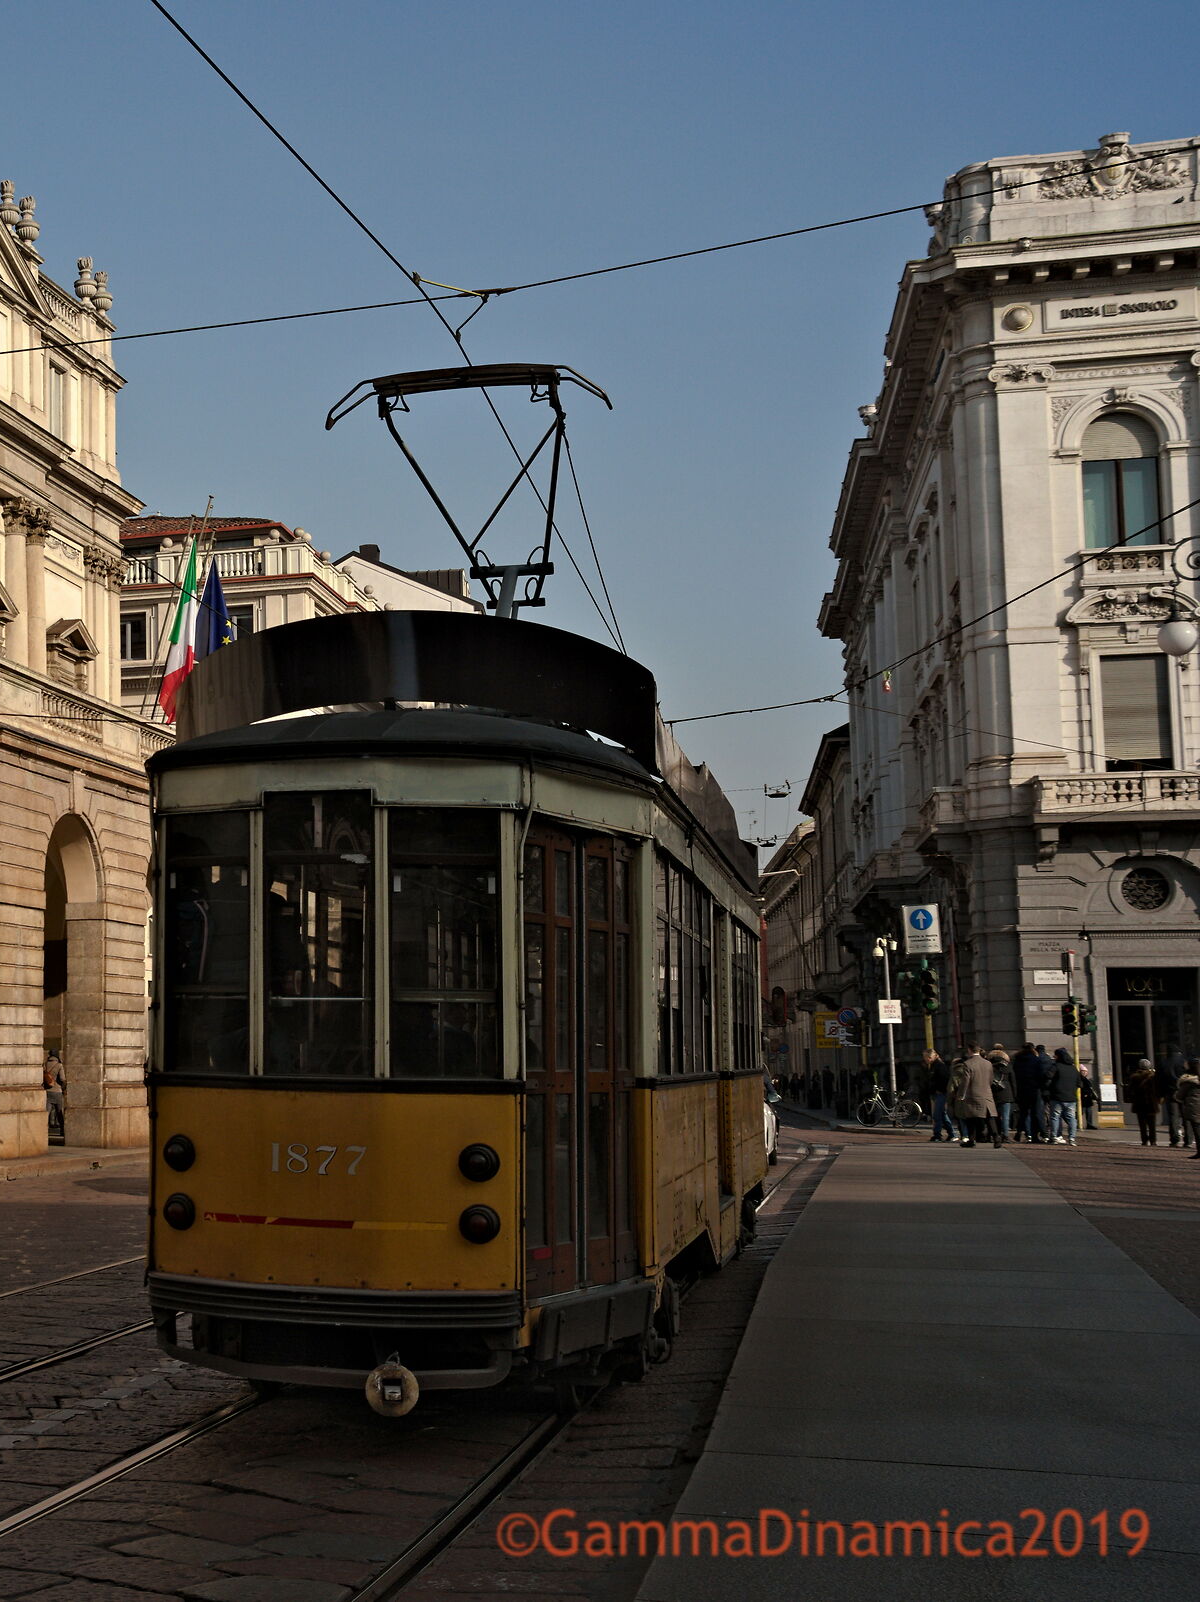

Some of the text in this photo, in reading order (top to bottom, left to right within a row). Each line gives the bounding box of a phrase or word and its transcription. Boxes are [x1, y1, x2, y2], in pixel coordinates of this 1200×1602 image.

[1060, 299, 1178, 320] INTESA SANPAOLO
[271, 1142, 368, 1176] 1877
